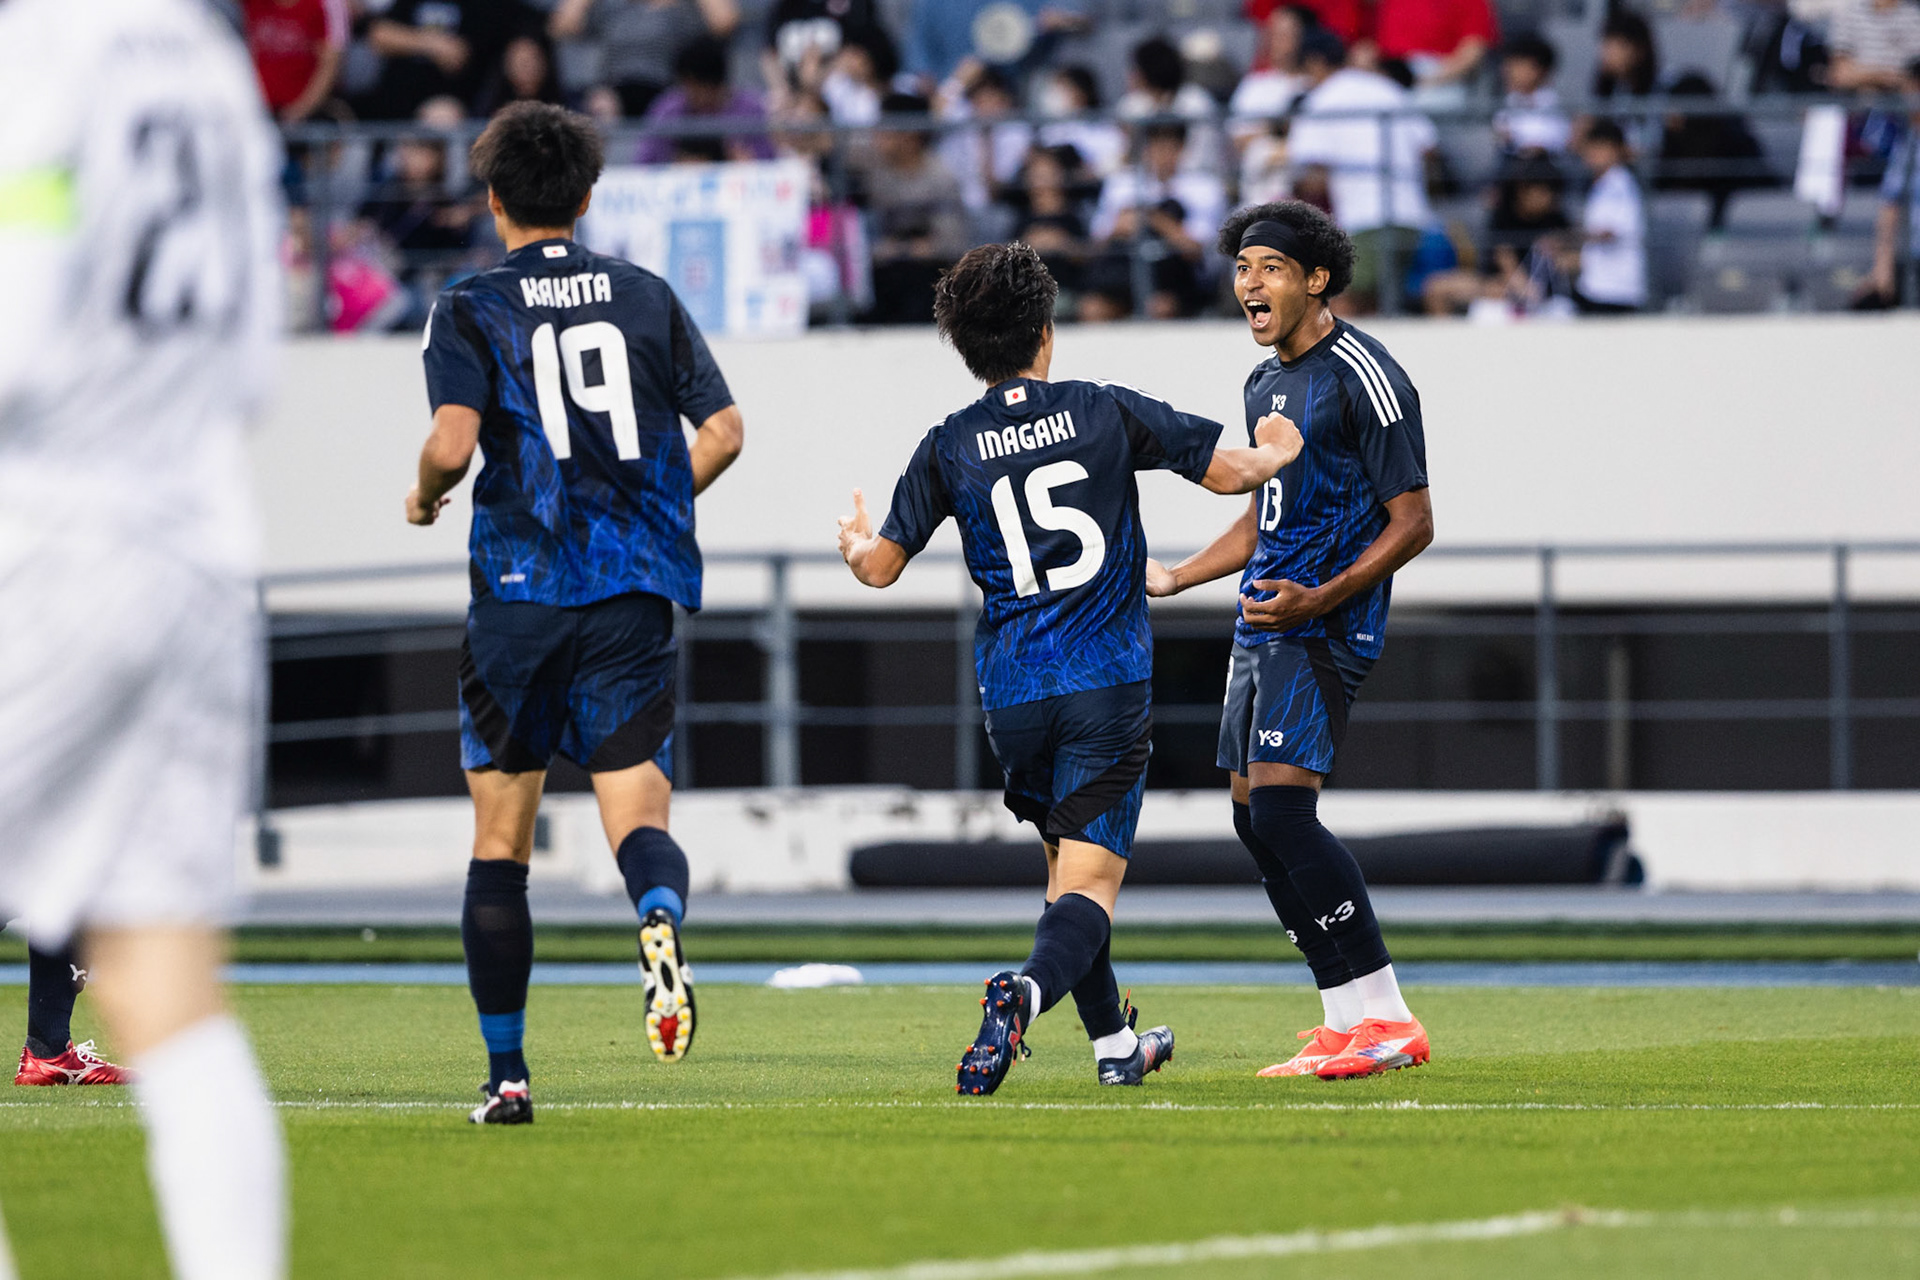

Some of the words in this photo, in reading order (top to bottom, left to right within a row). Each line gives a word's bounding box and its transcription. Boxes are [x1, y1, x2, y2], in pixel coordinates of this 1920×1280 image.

[519, 272, 612, 308] KAKITA
[530, 320, 641, 461] 19
[976, 410, 1077, 461] INAGAKI
[990, 460, 1106, 599] 15
[1260, 477, 1283, 532] 13
[1258, 729, 1284, 748] Y-3
[1314, 900, 1355, 931] Y-3
